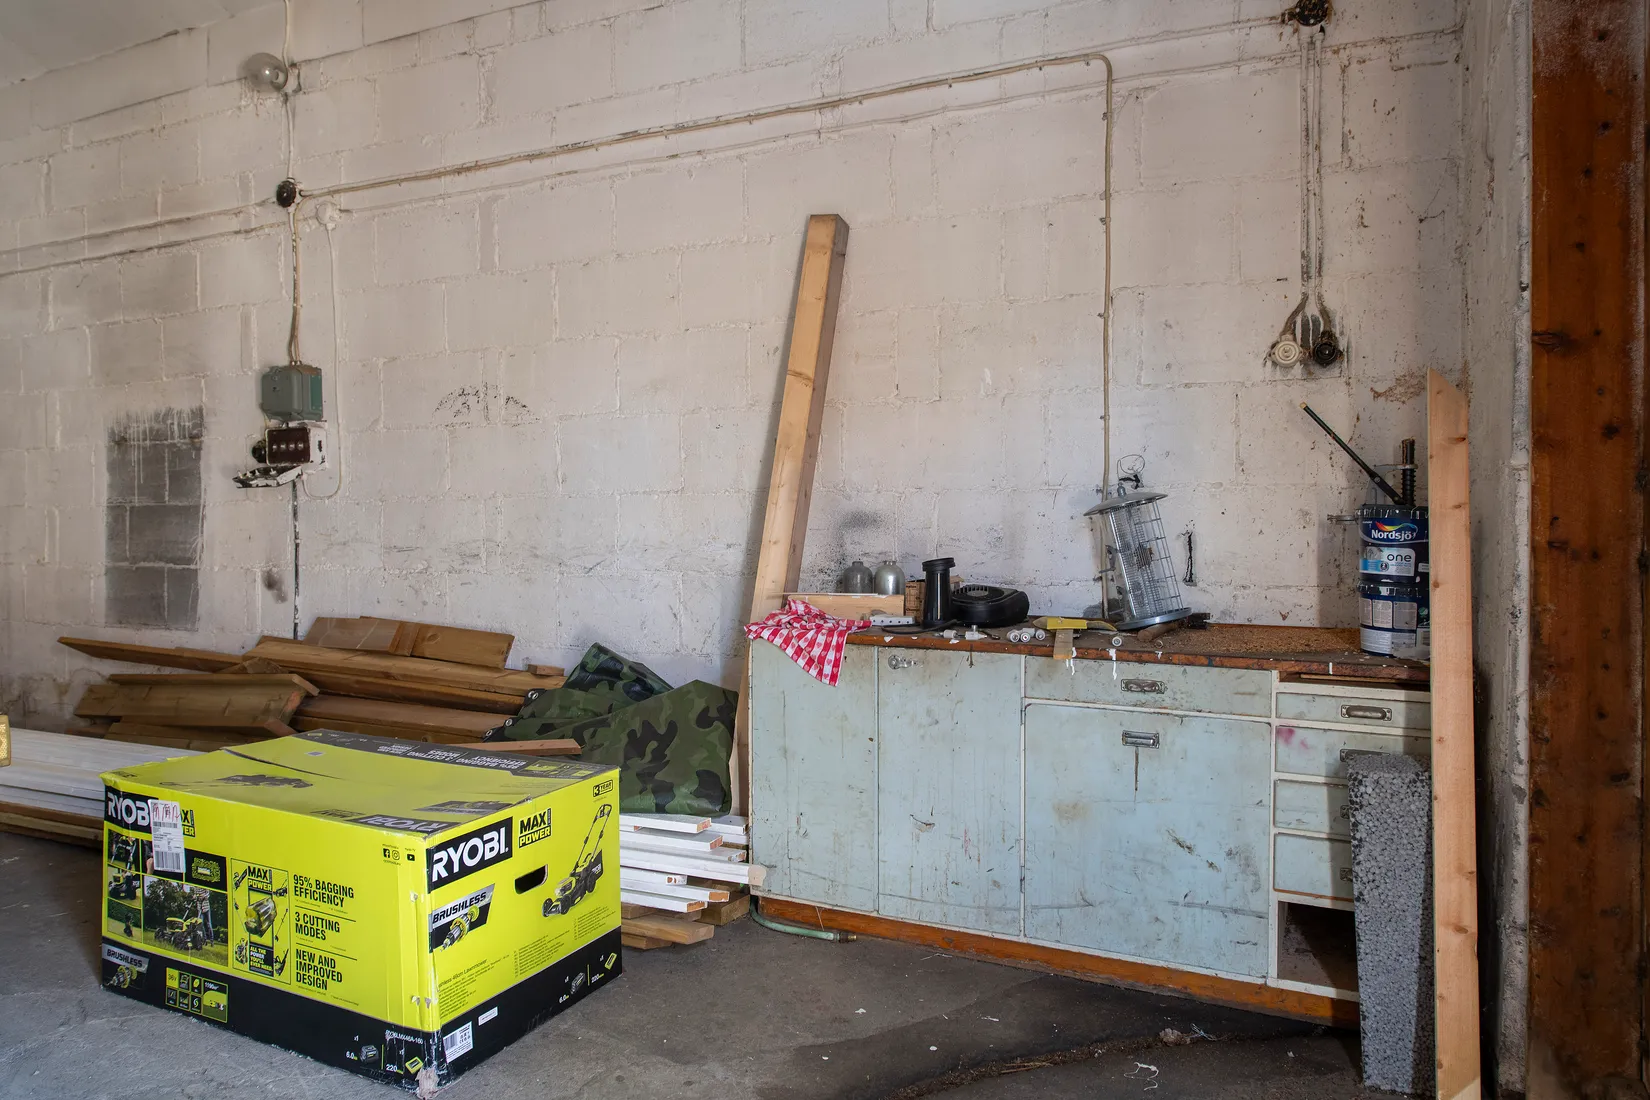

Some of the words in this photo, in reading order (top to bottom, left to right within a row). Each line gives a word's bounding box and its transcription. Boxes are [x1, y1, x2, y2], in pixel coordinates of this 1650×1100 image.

[1371, 529, 1412, 541] Nordsjö
[1387, 553, 1412, 563] one
[594, 784, 601, 797] 3
[107, 791, 150, 827] RYOB
[520, 811, 547, 835] MAX
[519, 828, 551, 847] POWER
[247, 866, 269, 881] MAX
[248, 879, 273, 892] POWER
[293, 874, 312, 889] 95%
[315, 879, 354, 899] BAGGING
[294, 885, 345, 908] EFFICIENCY
[432, 891, 488, 924] BRUSHLESS
[294, 911, 301, 923] 3
[302, 913, 340, 933] CUTTING
[295, 922, 326, 941] MODES
[106, 949, 143, 968] BRUSHLESS
[296, 948, 316, 964] NEW
[318, 954, 336, 970] AND
[296, 960, 343, 983] IMPROVED
[296, 971, 328, 991] DESIGN
